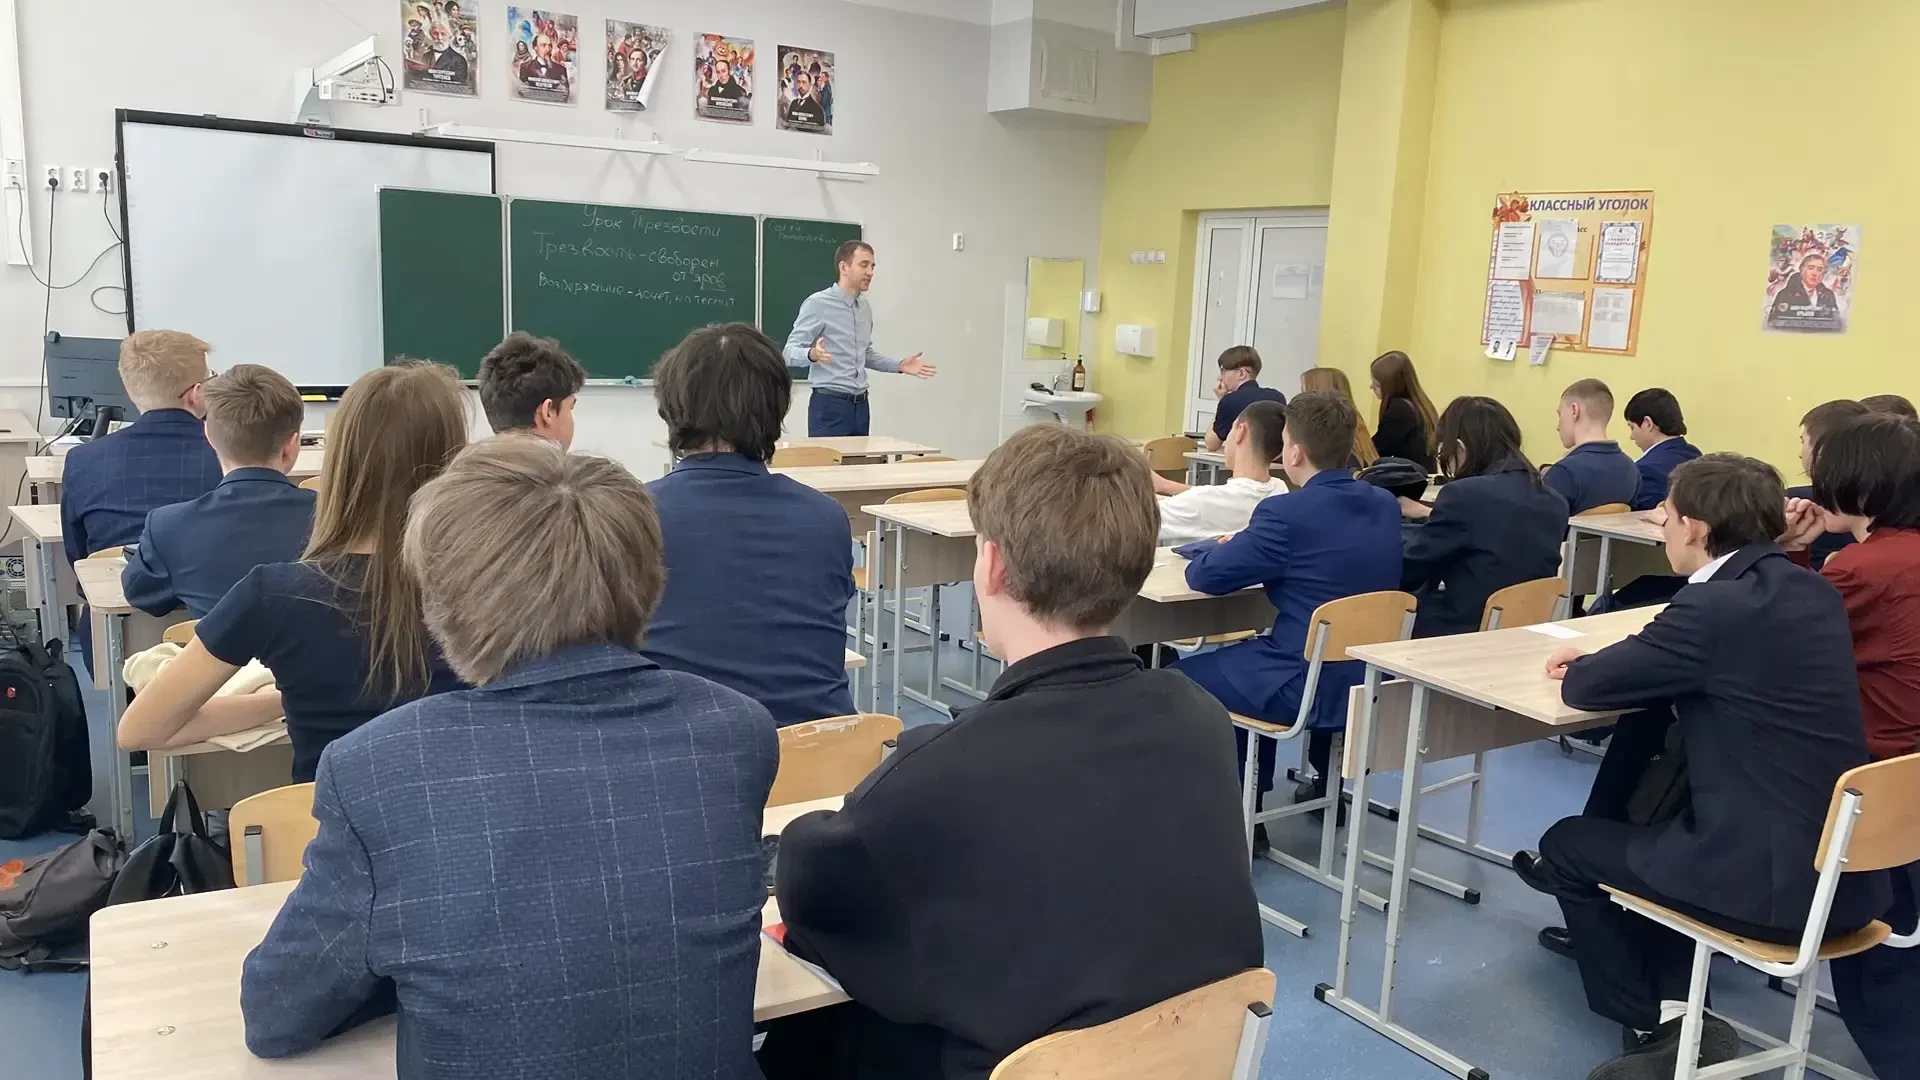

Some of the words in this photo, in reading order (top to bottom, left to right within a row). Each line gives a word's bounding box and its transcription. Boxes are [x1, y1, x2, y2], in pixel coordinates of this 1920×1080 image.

[1529, 196, 1595, 211] КЛАССНЫЙ
[1598, 198, 1649, 210] УГОЛОК
[582, 204, 622, 232] Урок
[632, 209, 720, 238] Трезвости
